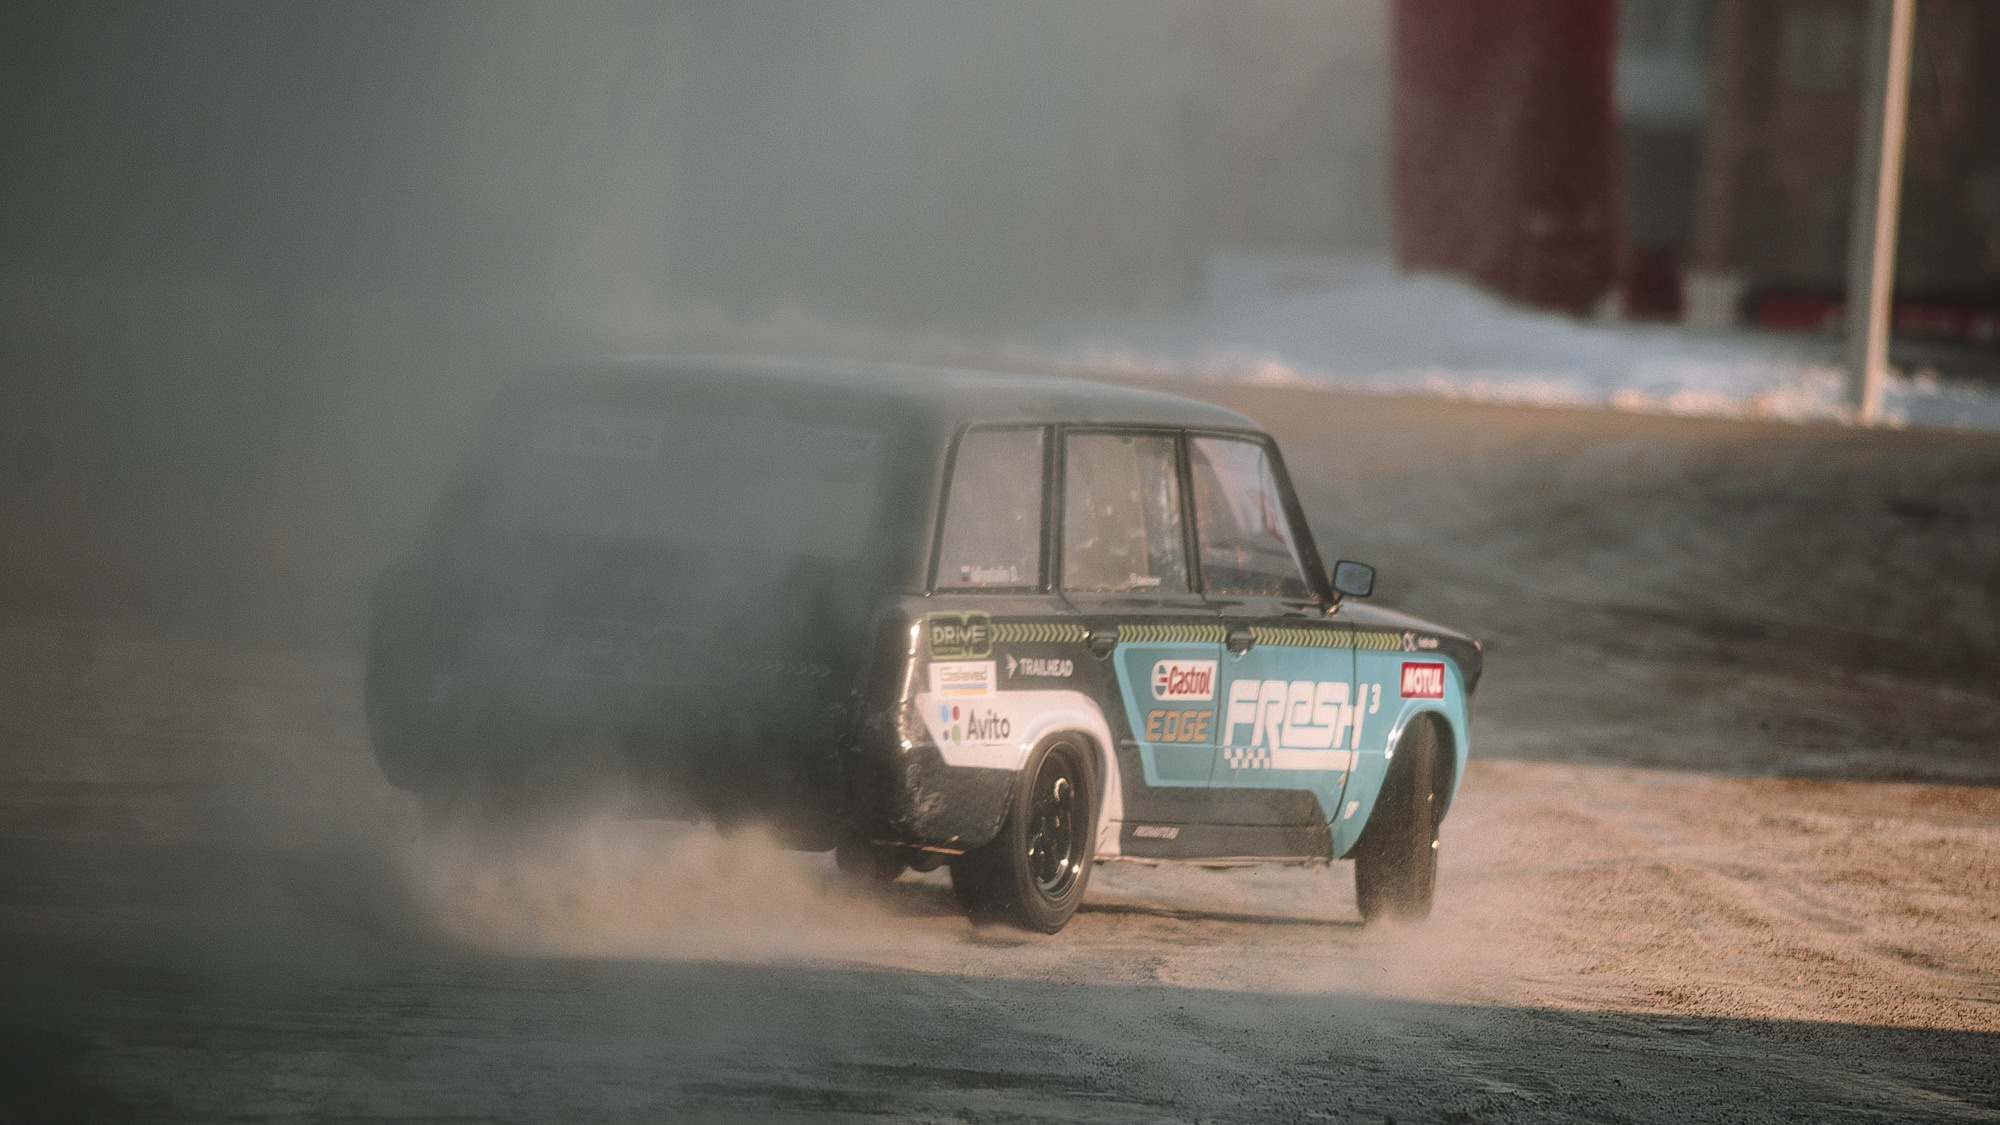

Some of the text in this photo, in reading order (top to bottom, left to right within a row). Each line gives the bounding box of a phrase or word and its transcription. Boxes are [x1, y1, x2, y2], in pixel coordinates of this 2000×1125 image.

[932, 625, 988, 646] DRIVE
[1019, 658, 1074, 677] TRAILHEAD
[1167, 665, 1213, 695] Castrol
[1402, 667, 1442, 694] MOTUL
[966, 709, 1011, 741] Avito
[1145, 709, 1213, 743] EDGE
